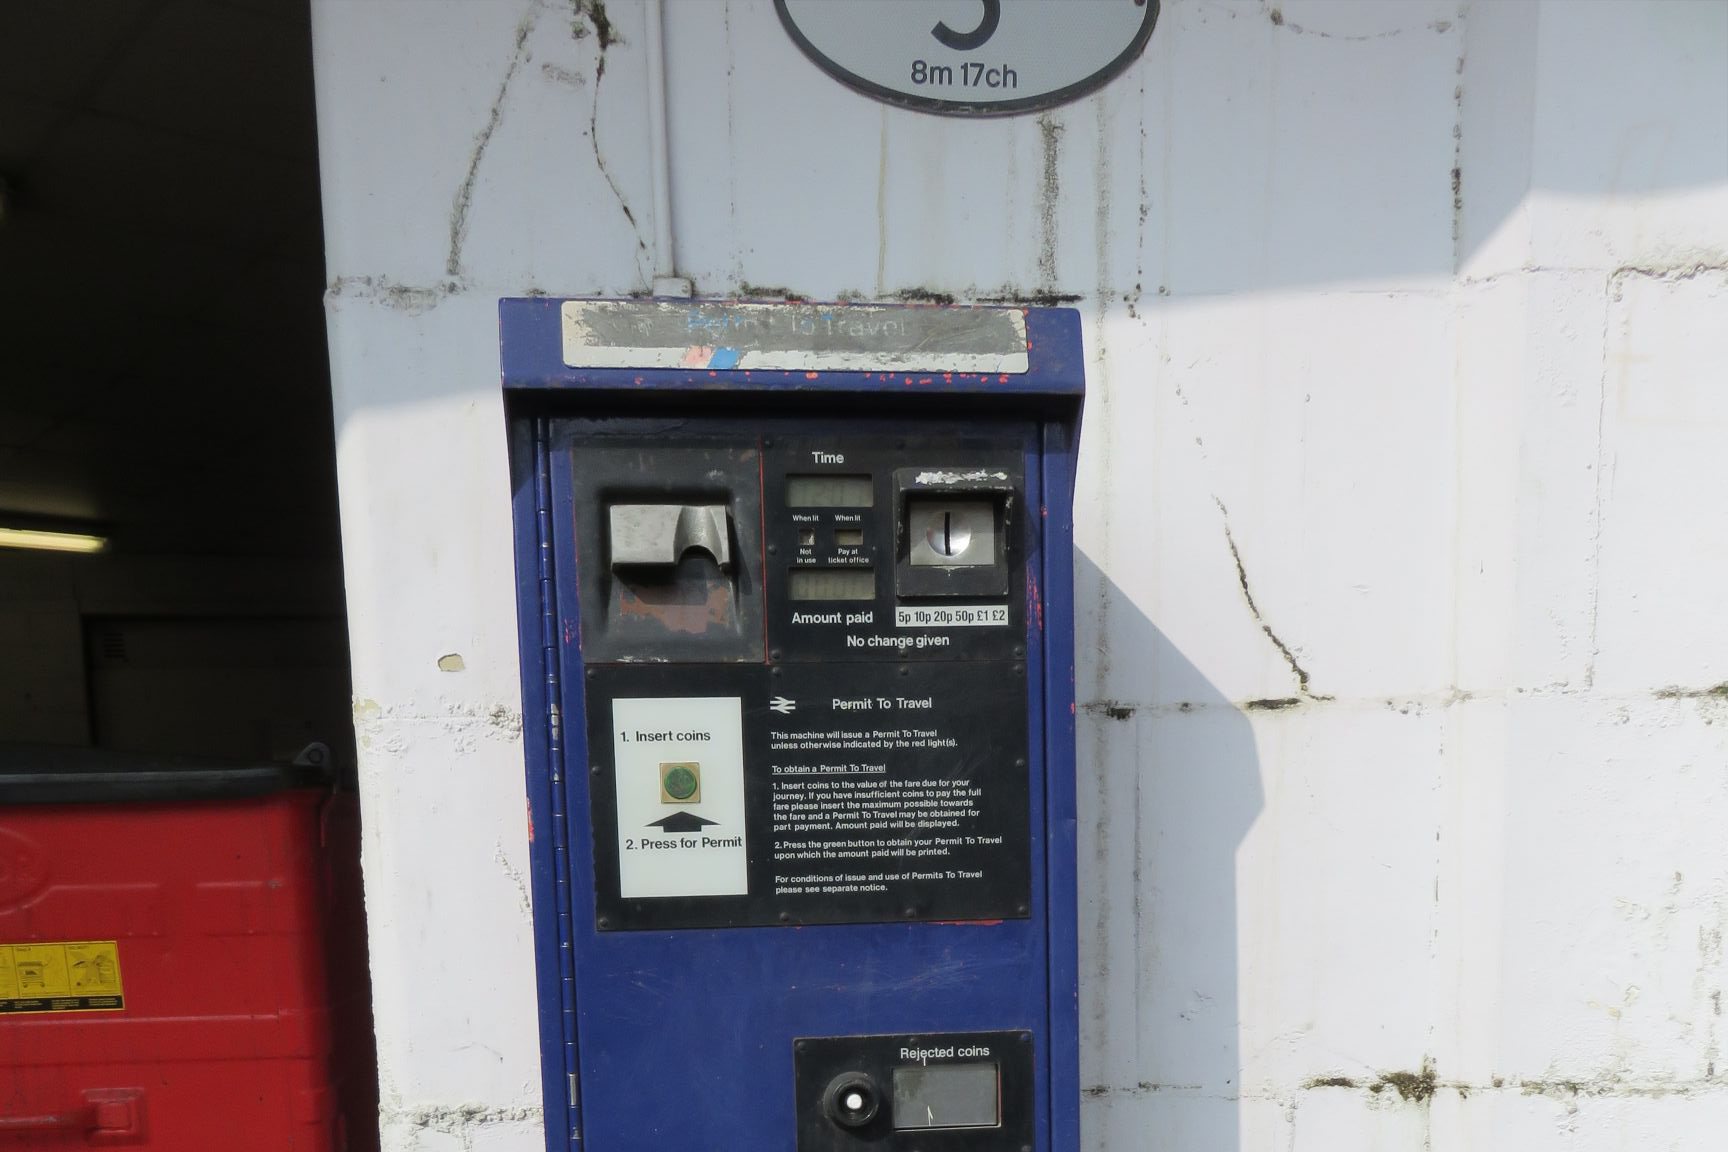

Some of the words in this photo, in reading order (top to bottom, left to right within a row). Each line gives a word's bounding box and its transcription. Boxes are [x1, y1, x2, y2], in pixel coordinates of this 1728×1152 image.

[910, 60, 952, 85] 8m
[960, 62, 1018, 88] 17ch
[812, 451, 845, 464] Time
[838, 548, 849, 556] Pay
[791, 612, 842, 623] Amount
[846, 612, 873, 625] paid
[899, 611, 911, 625] 5p
[914, 611, 931, 624] 10p
[934, 610, 952, 624] 20p
[955, 610, 974, 624] 50p
[977, 610, 989, 621] £1
[992, 610, 1006, 621] £2
[847, 635, 865, 647] No
[867, 635, 914, 649] change
[916, 634, 950, 648] given
[832, 698, 872, 710] Permit
[877, 698, 891, 709] To
[896, 697, 932, 709] Travel
[620, 731, 629, 742] 1.
[636, 731, 673, 742] Insert
[676, 730, 711, 741] coins
[771, 731, 789, 740] This
[790, 731, 825, 739] machine
[826, 731, 840, 739] will
[841, 730, 863, 739] issue
[872, 730, 900, 738] Permit
[902, 729, 912, 738] To
[913, 729, 938, 737] Travel
[771, 741, 798, 749] unless
[800, 740, 842, 749] otherwise
[843, 740, 881, 748] indicated
[883, 740, 894, 749] by
[895, 739, 910, 748] the
[911, 739, 926, 747] red
[927, 739, 958, 749] light(s).
[772, 765, 782, 773] To
[783, 765, 810, 773] obtain
[820, 764, 847, 773] Permit
[849, 764, 860, 772] To
[862, 764, 886, 772] Travel
[772, 782, 779, 790] 1.
[781, 781, 805, 790] Insert
[807, 781, 829, 789] coins
[831, 781, 840, 789] to
[841, 781, 855, 789] the
[856, 780, 878, 789] value
[879, 780, 888, 788] of
[889, 780, 903, 788] the
[904, 779, 920, 788] fare
[921, 779, 936, 787] due
[938, 779, 950, 787] for
[951, 780, 969, 788] your
[773, 793, 807, 802] journey.
[808, 791, 814, 799] If
[816, 793, 831, 801] you
[833, 791, 852, 799] have
[854, 790, 900, 799] insufficient
[902, 789, 924, 798] coins
[926, 789, 934, 797] to
[936, 790, 951, 799] pay
[953, 788, 967, 797] the
[968, 788, 982, 796] full
[773, 802, 790, 810] fare
[791, 801, 819, 812] please
[820, 801, 845, 809] insert
[846, 801, 860, 809] the
[862, 800, 902, 809] maximum
[904, 799, 938, 810] possible
[940, 799, 973, 807] towards
[773, 812, 787, 821] the
[789, 812, 806, 820] fare
[808, 812, 824, 820] and
[832, 811, 859, 819] Permit
[862, 811, 871, 819] To
[872, 810, 897, 819] Travel
[898, 812, 916, 820] may
[918, 810, 928, 818] be
[930, 809, 966, 818] obtained
[968, 809, 980, 817] for
[773, 822, 792, 832] part
[794, 821, 833, 832] payment.
[835, 821, 868, 829] Amount
[870, 820, 887, 830] paid
[889, 820, 904, 828] will
[904, 820, 915, 828] be
[917, 819, 960, 829] displayed.
[626, 839, 638, 850] 2.
[641, 838, 677, 849] Press
[680, 837, 698, 848] for
[702, 836, 742, 848] Permit
[774, 841, 783, 849] 2.
[783, 840, 807, 849] Press
[808, 840, 822, 848] the
[823, 841, 846, 850] green
[847, 839, 875, 847] button
[876, 838, 885, 847] to
[886, 838, 912, 846] obtain
[914, 839, 933, 847] your
[935, 837, 962, 845] Permit
[965, 836, 975, 845] To
[977, 836, 1003, 844] Travel
[774, 852, 796, 861] upon
[797, 850, 821, 859] which
[823, 850, 836, 858] the
[837, 849, 869, 858] amount
[871, 848, 890, 859] paid
[891, 848, 904, 856] will
[905, 848, 916, 856] be
[918, 847, 950, 858] printed.
[775, 875, 789, 883] For
[790, 874, 833, 883] conditions
[835, 873, 843, 882] of
[845, 873, 866, 881] issue
[868, 872, 883, 881] and
[901, 872, 910, 880] of
[911, 871, 943, 880] Permits
[946, 871, 956, 879] To
[957, 870, 983, 879] Travel
[775, 885, 803, 895] please
[822, 883, 858, 894] separate
[860, 883, 888, 891] notice.
[900, 1046, 954, 1061] Rejected
[958, 1045, 990, 1057] coins
